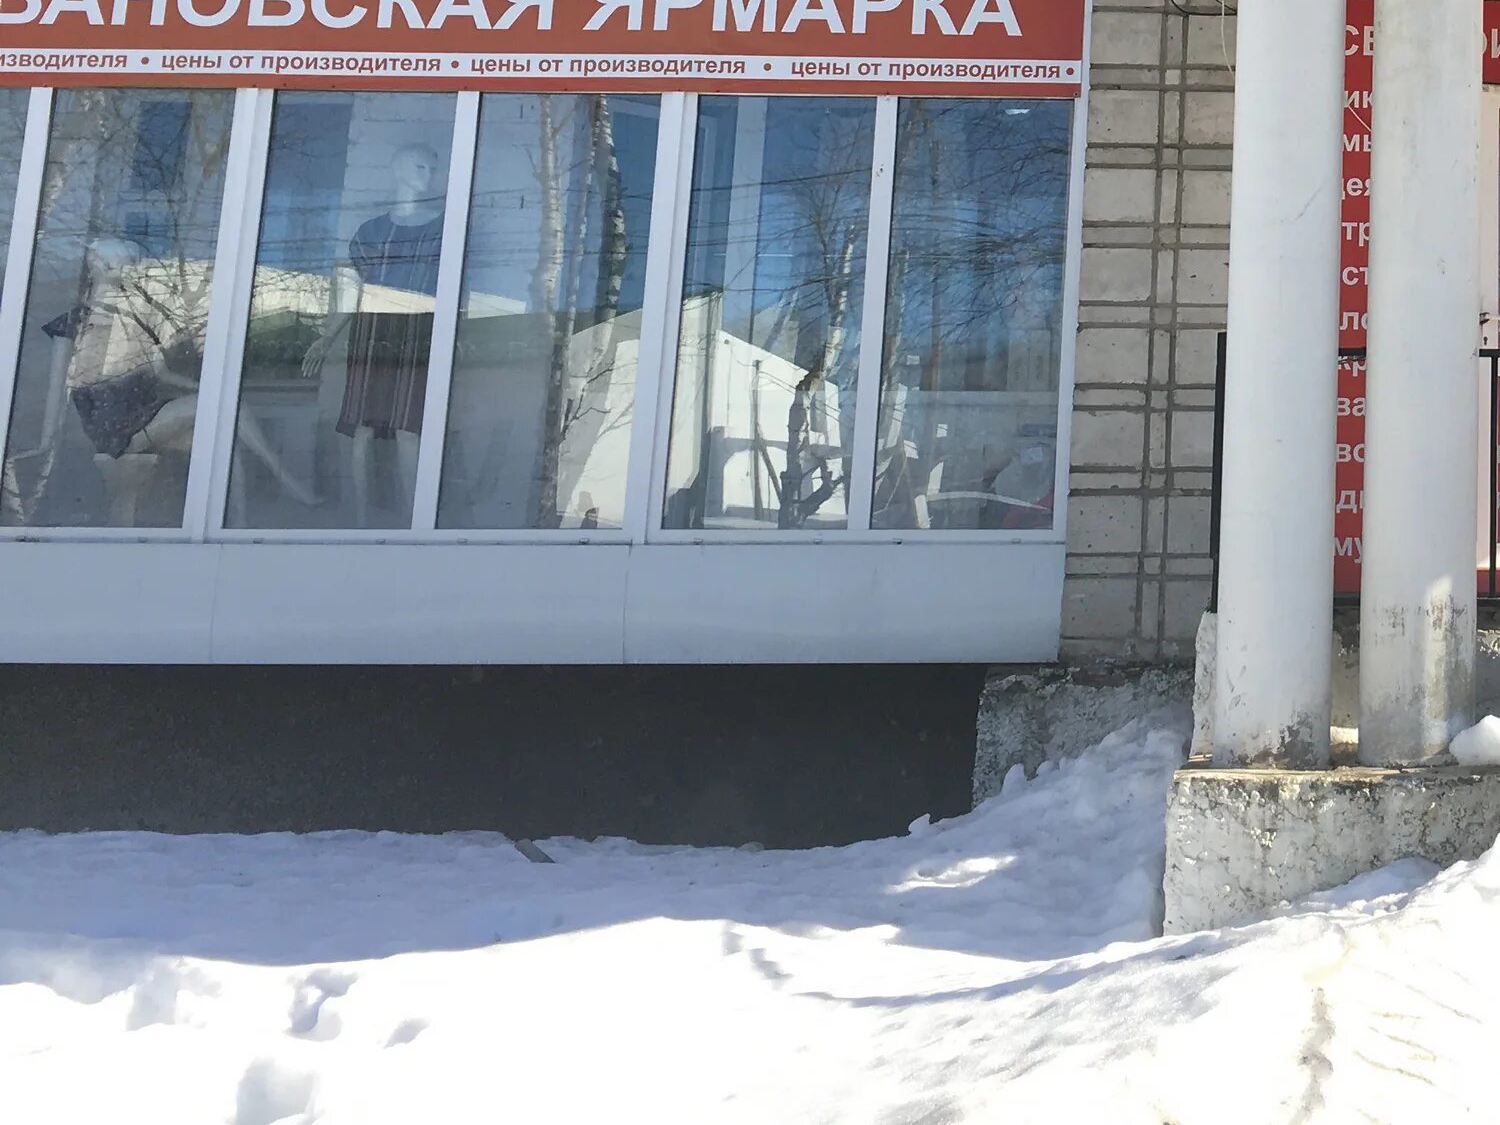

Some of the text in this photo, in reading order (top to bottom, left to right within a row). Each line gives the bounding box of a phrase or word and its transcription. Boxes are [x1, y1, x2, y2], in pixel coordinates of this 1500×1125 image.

[161, 52, 222, 72] цены
[230, 54, 254, 69] от
[260, 52, 441, 74] производителя
[470, 56, 531, 75] цены
[538, 58, 561, 73] от
[569, 57, 746, 78] производителя
[791, 59, 850, 78] цены
[857, 61, 882, 76] от
[888, 61, 1061, 81] производителя
